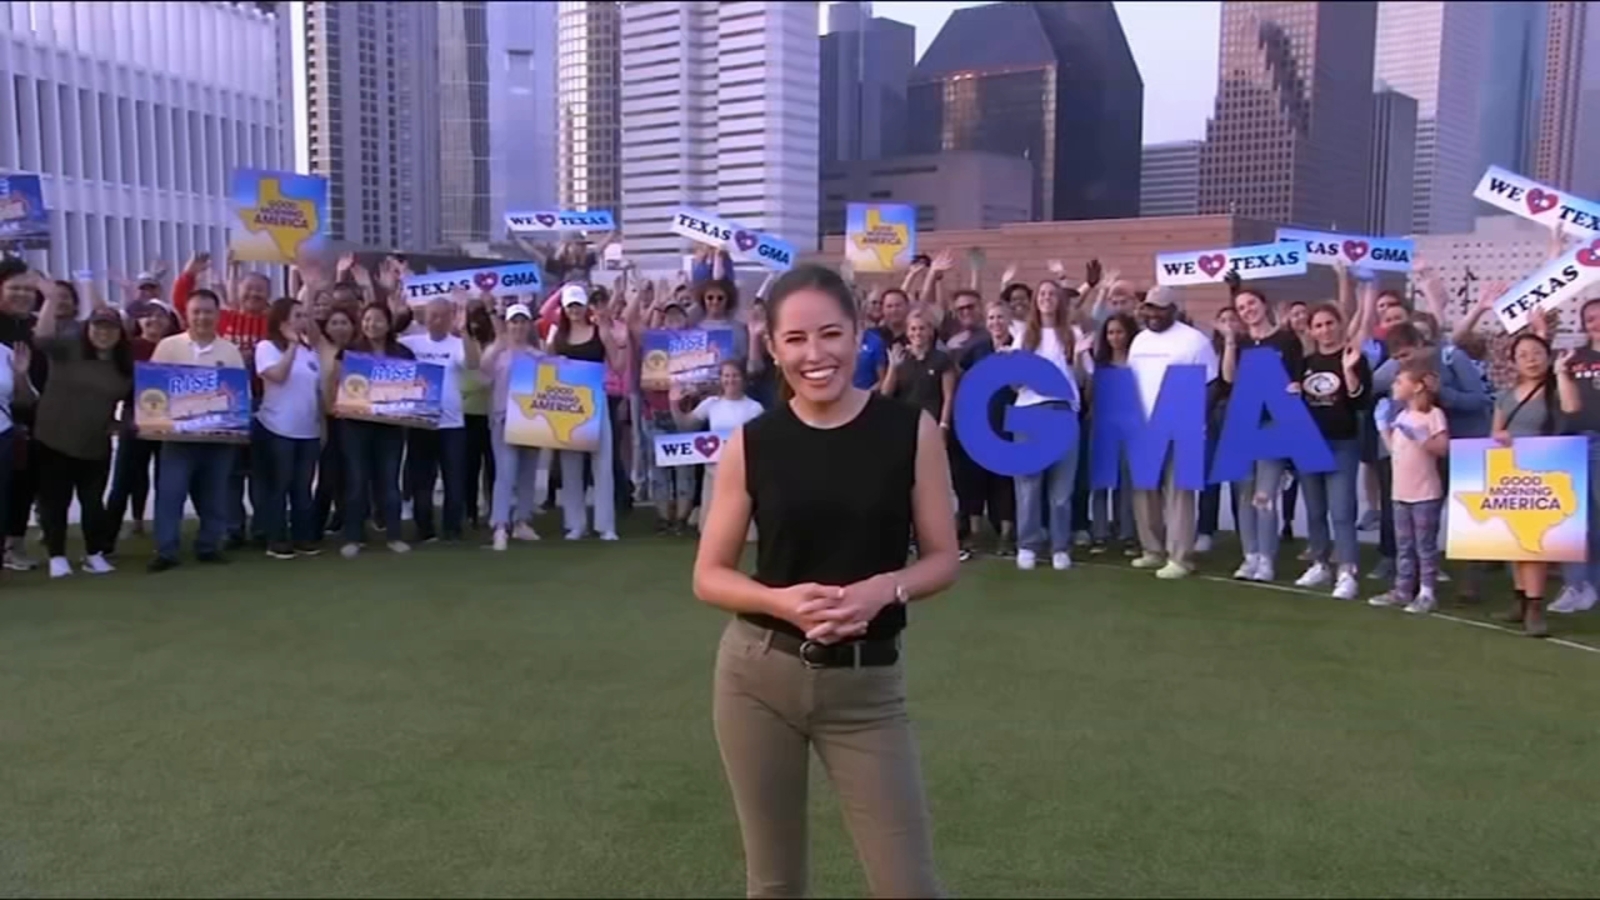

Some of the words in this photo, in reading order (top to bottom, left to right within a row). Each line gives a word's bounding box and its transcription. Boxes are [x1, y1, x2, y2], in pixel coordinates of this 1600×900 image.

[1490, 178, 1524, 201] WE
[253, 213, 308, 228] AMERICA
[510, 216, 535, 226] WE
[558, 216, 610, 226] TEXAS
[679, 213, 732, 241] TEXAS
[758, 243, 790, 266] GMA
[1371, 247, 1410, 263] GMA
[1164, 261, 1196, 277] WE
[1229, 250, 1299, 272] TEXAS
[502, 271, 539, 288] GMA
[1501, 265, 1579, 320] TEXAS
[371, 362, 417, 381] RISE
[168, 370, 219, 395] RISE
[530, 400, 585, 414] AMERICA
[954, 347, 1336, 490] GMA
[660, 442, 694, 457] WE
[1499, 476, 1542, 486] GOOD
[1489, 486, 1553, 497] MORNING
[1480, 497, 1561, 510] AMERICA
